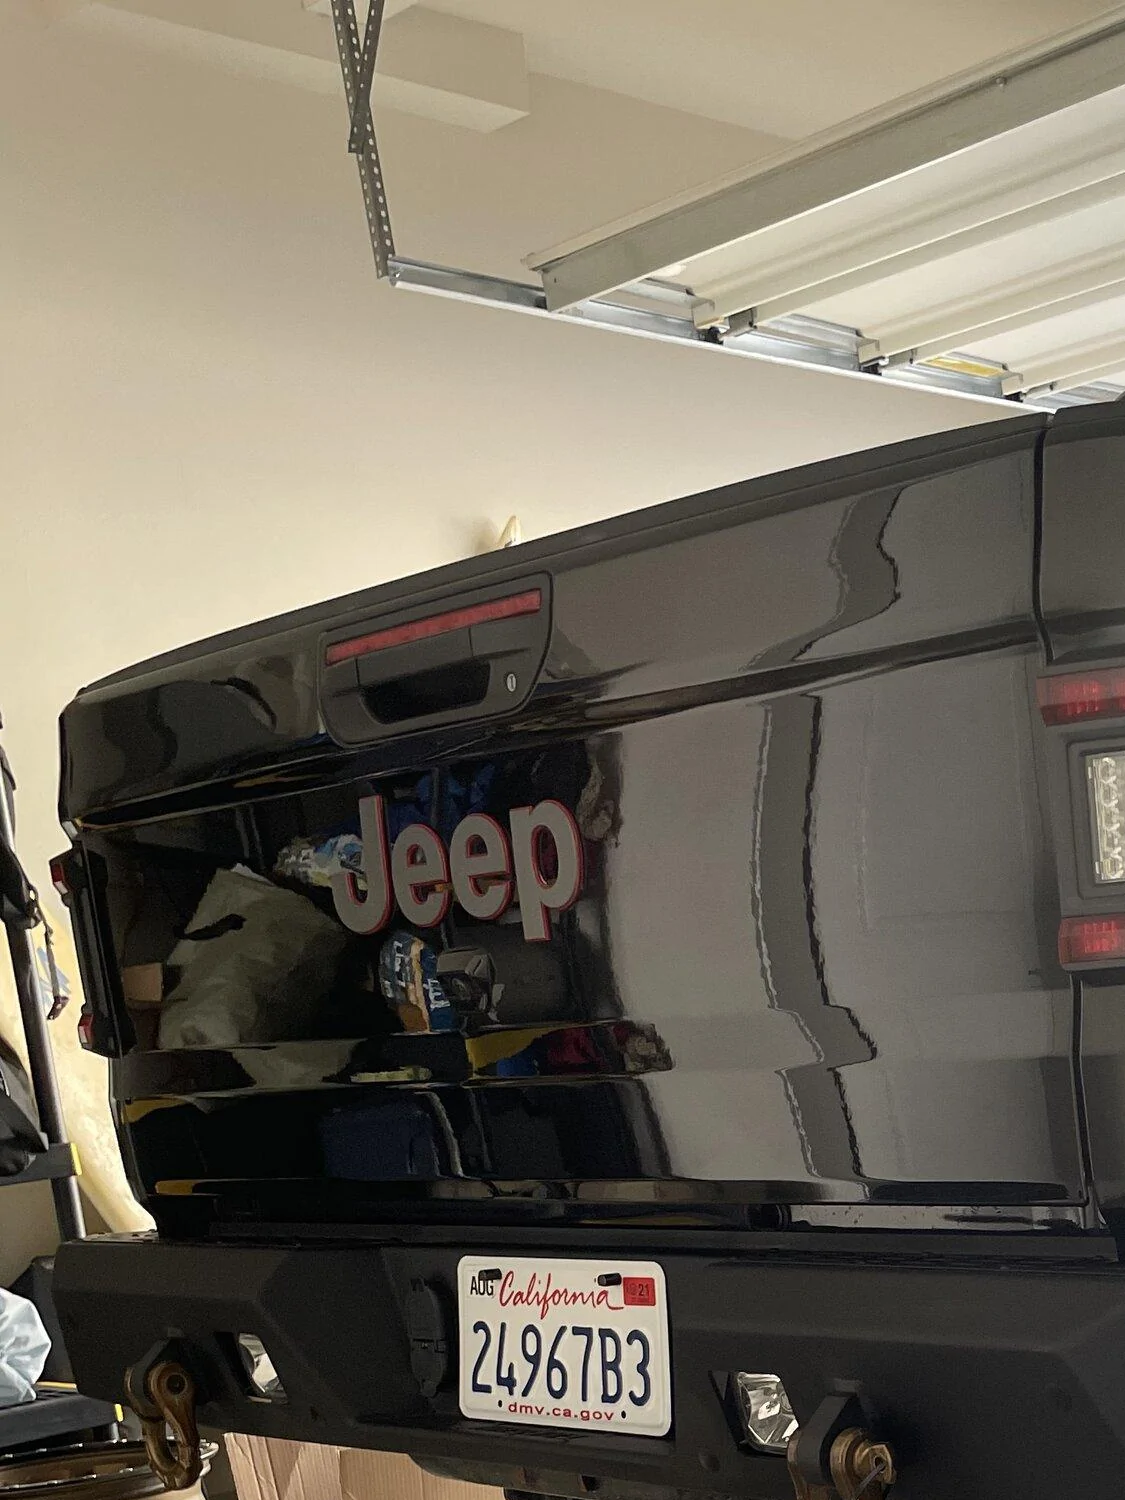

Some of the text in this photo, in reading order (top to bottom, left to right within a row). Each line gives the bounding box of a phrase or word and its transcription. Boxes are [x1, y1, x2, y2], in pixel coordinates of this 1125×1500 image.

[331, 794, 584, 942] Jeep
[470, 1276, 494, 1296] AUG
[500, 1271, 624, 1319] California
[472, 1320, 651, 1406] 24967B3
[508, 1402, 614, 1421] dmv.ca.gov
